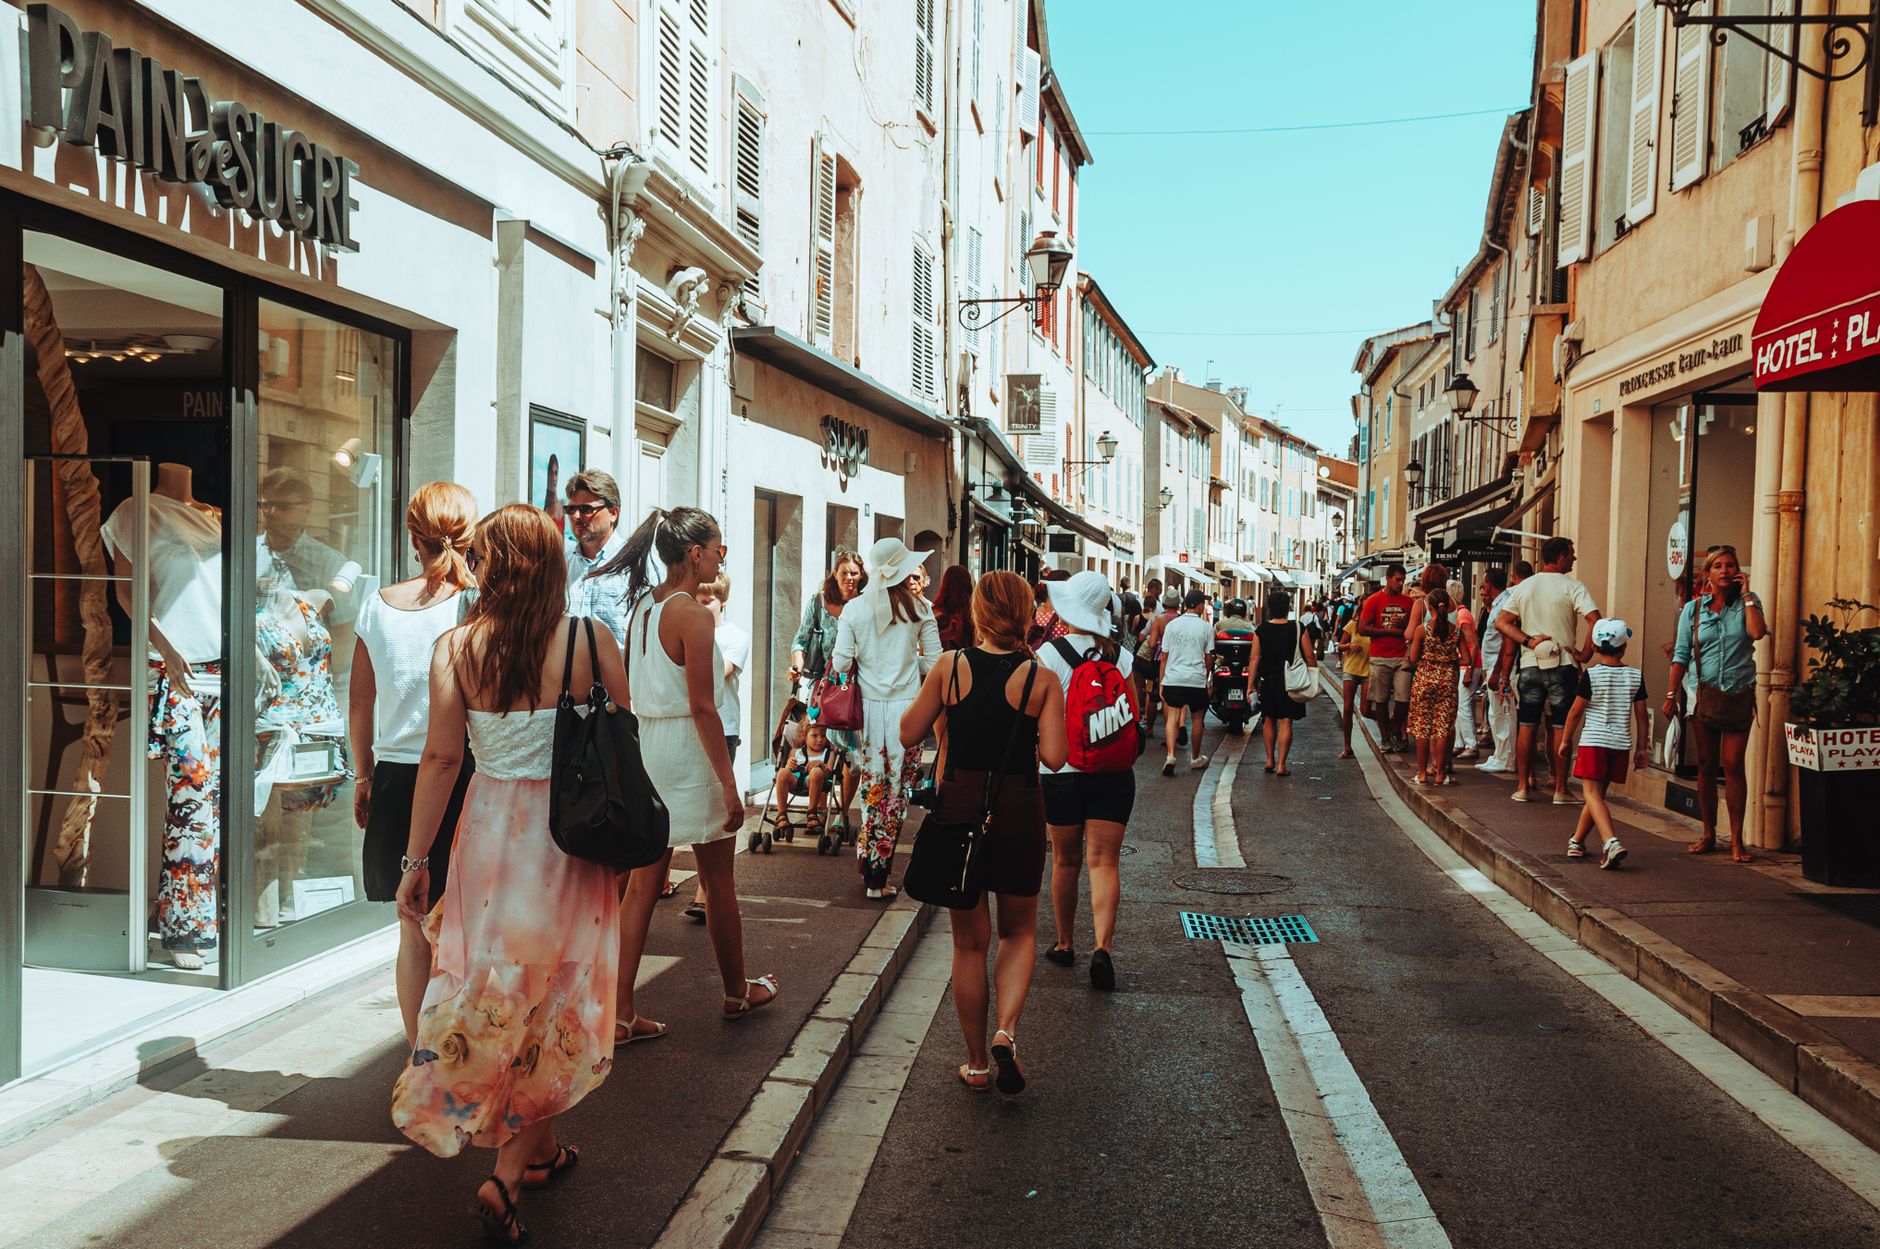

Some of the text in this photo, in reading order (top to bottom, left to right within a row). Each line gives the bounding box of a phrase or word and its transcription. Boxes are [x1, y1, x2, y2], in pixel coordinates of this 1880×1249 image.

[28, 3, 192, 183] PAIN
[214, 101, 360, 253] SUCRE
[1756, 311, 1880, 378] HOTEL PL
[183, 391, 223, 418] PAIN
[1089, 692, 1134, 744] NIKE
[1789, 743, 1816, 758] PLAYA
